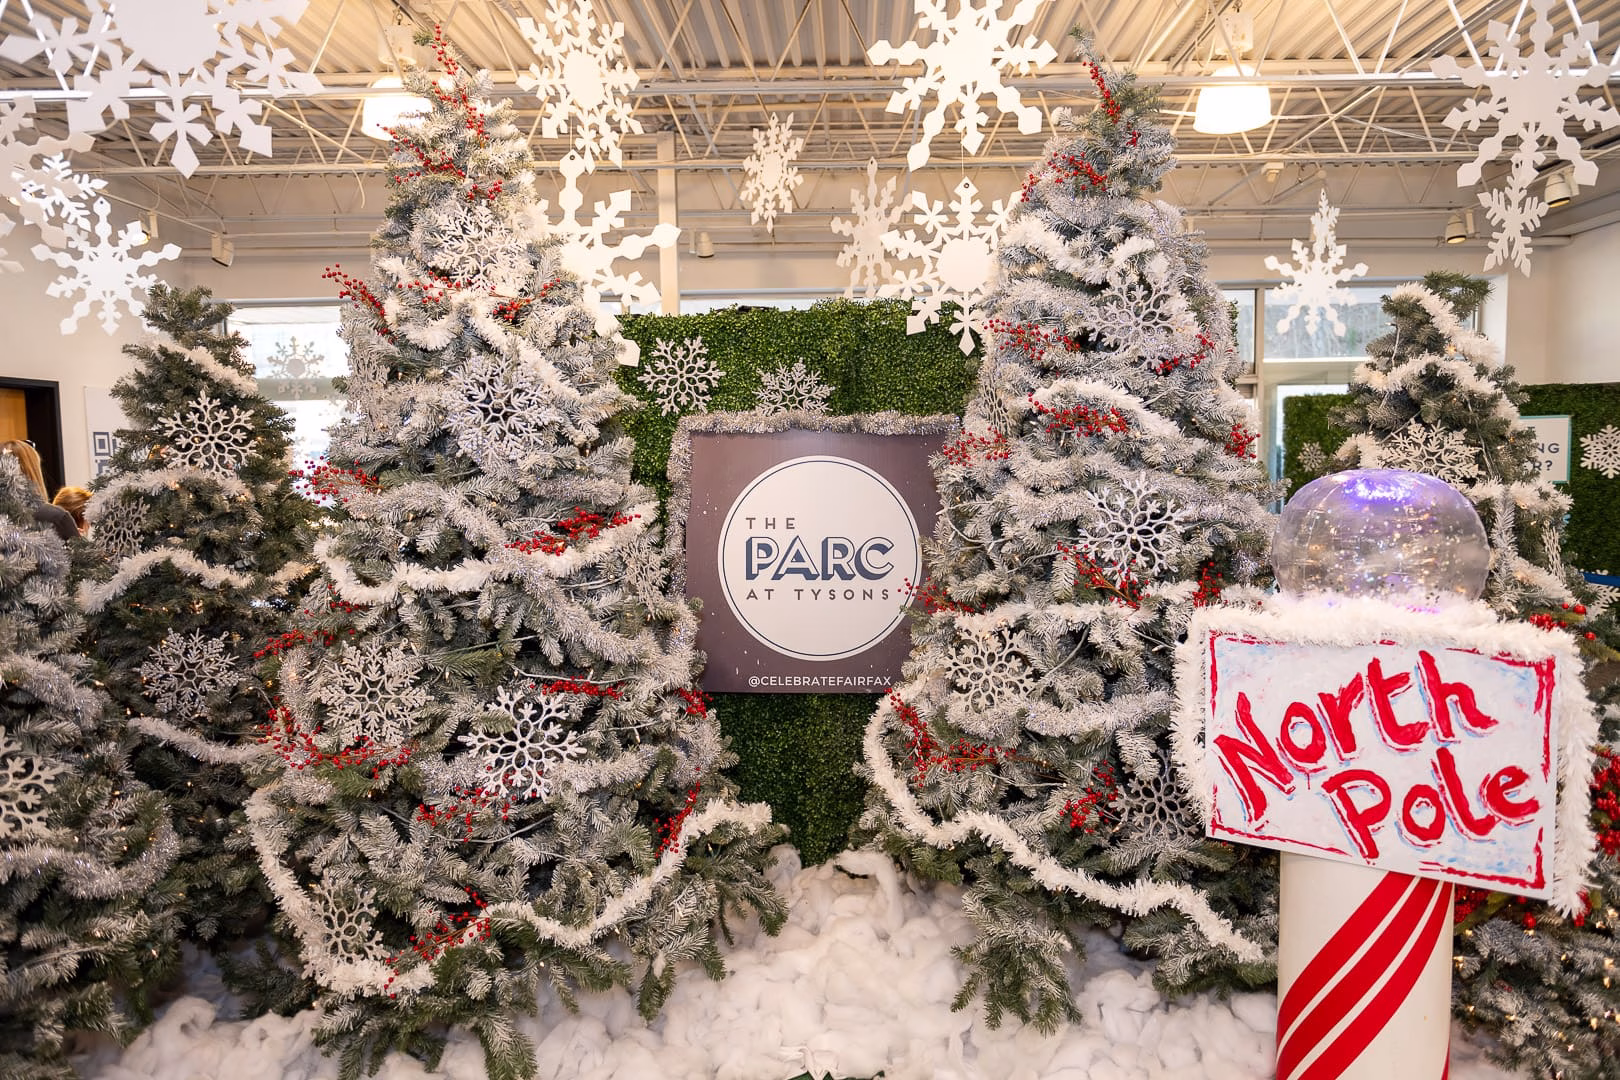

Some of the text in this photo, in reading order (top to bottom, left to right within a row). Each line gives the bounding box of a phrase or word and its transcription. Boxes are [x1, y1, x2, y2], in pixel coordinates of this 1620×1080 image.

[746, 518, 796, 529] THE
[746, 535, 895, 581] PARC
[746, 589, 889, 600] AT TYSONS
[749, 677, 891, 687] @CELEBRATEFAIRFAX
[1213, 650, 1499, 827] North
[1321, 747, 1541, 861] Pole
